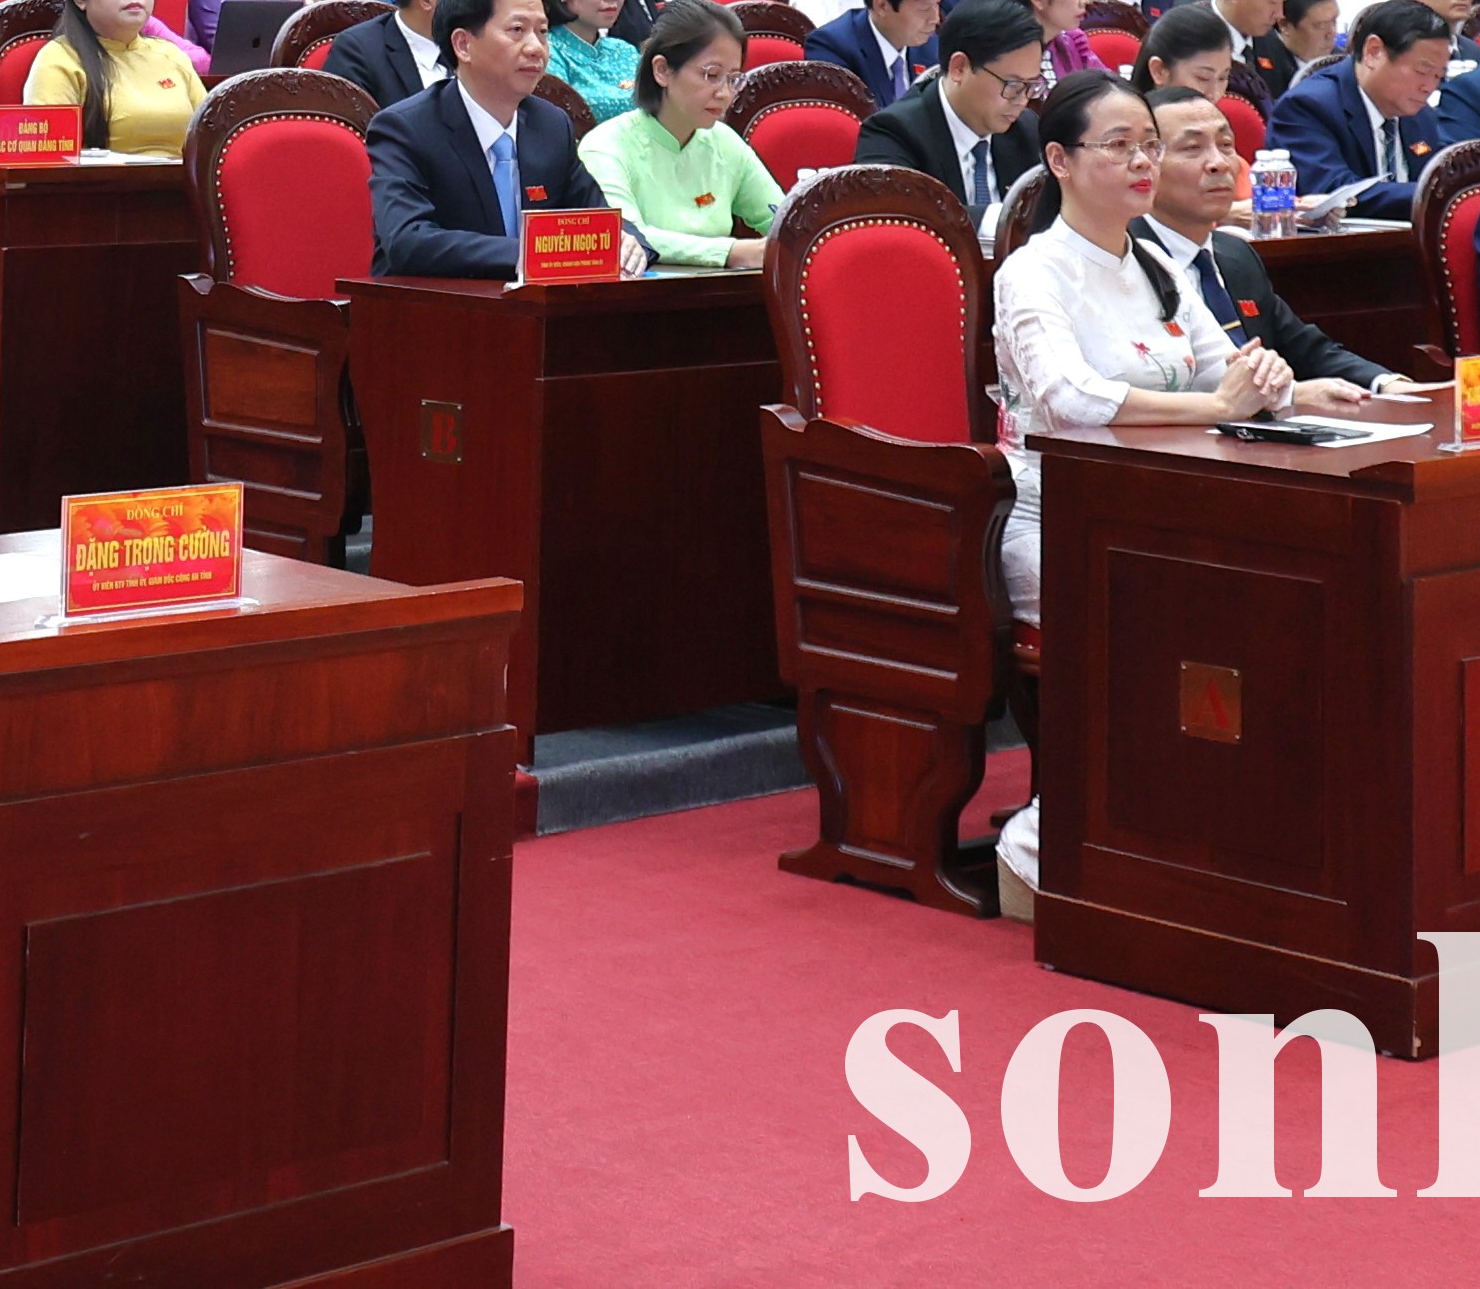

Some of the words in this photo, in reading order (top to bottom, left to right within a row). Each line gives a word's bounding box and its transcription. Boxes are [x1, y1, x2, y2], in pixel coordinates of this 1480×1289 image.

[18, 118, 38, 135] ĐẢNG
[39, 119, 49, 136] BỘ
[7, 139, 18, 153] CƠ
[18, 140, 37, 153] QUAN
[38, 136, 57, 152] ĐẢNG
[58, 135, 74, 152] TỈNH
[577, 216, 590, 225] CHÍ
[534, 228, 572, 254] NGUYỄN
[572, 233, 598, 255] NGỌC
[599, 229, 611, 250] TÚ
[126, 504, 160, 521] ĐỒNG
[162, 502, 184, 518] CHÍ
[75, 537, 120, 577] ĐẶNG
[123, 535, 175, 572] TRỌNG
[178, 526, 230, 562] CƯỜNG
